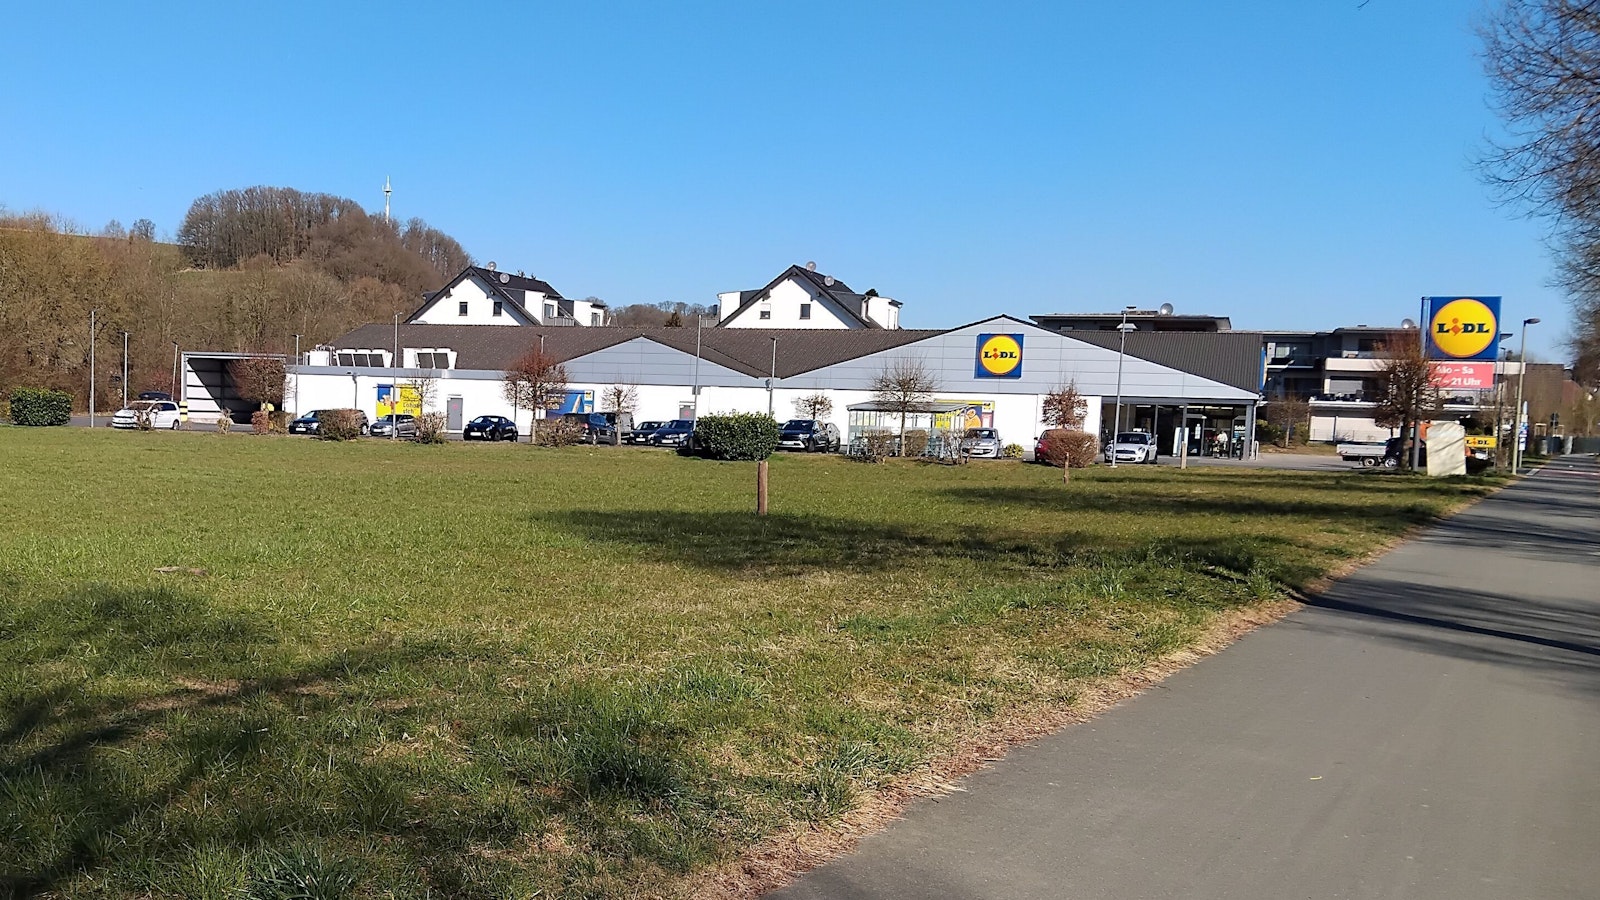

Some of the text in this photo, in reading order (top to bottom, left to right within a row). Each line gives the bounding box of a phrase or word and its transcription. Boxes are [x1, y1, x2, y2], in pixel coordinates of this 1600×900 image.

[1461, 366, 1474, 374] Sa
[1451, 377, 1462, 386] 21
[1463, 377, 1481, 386] Uhr
